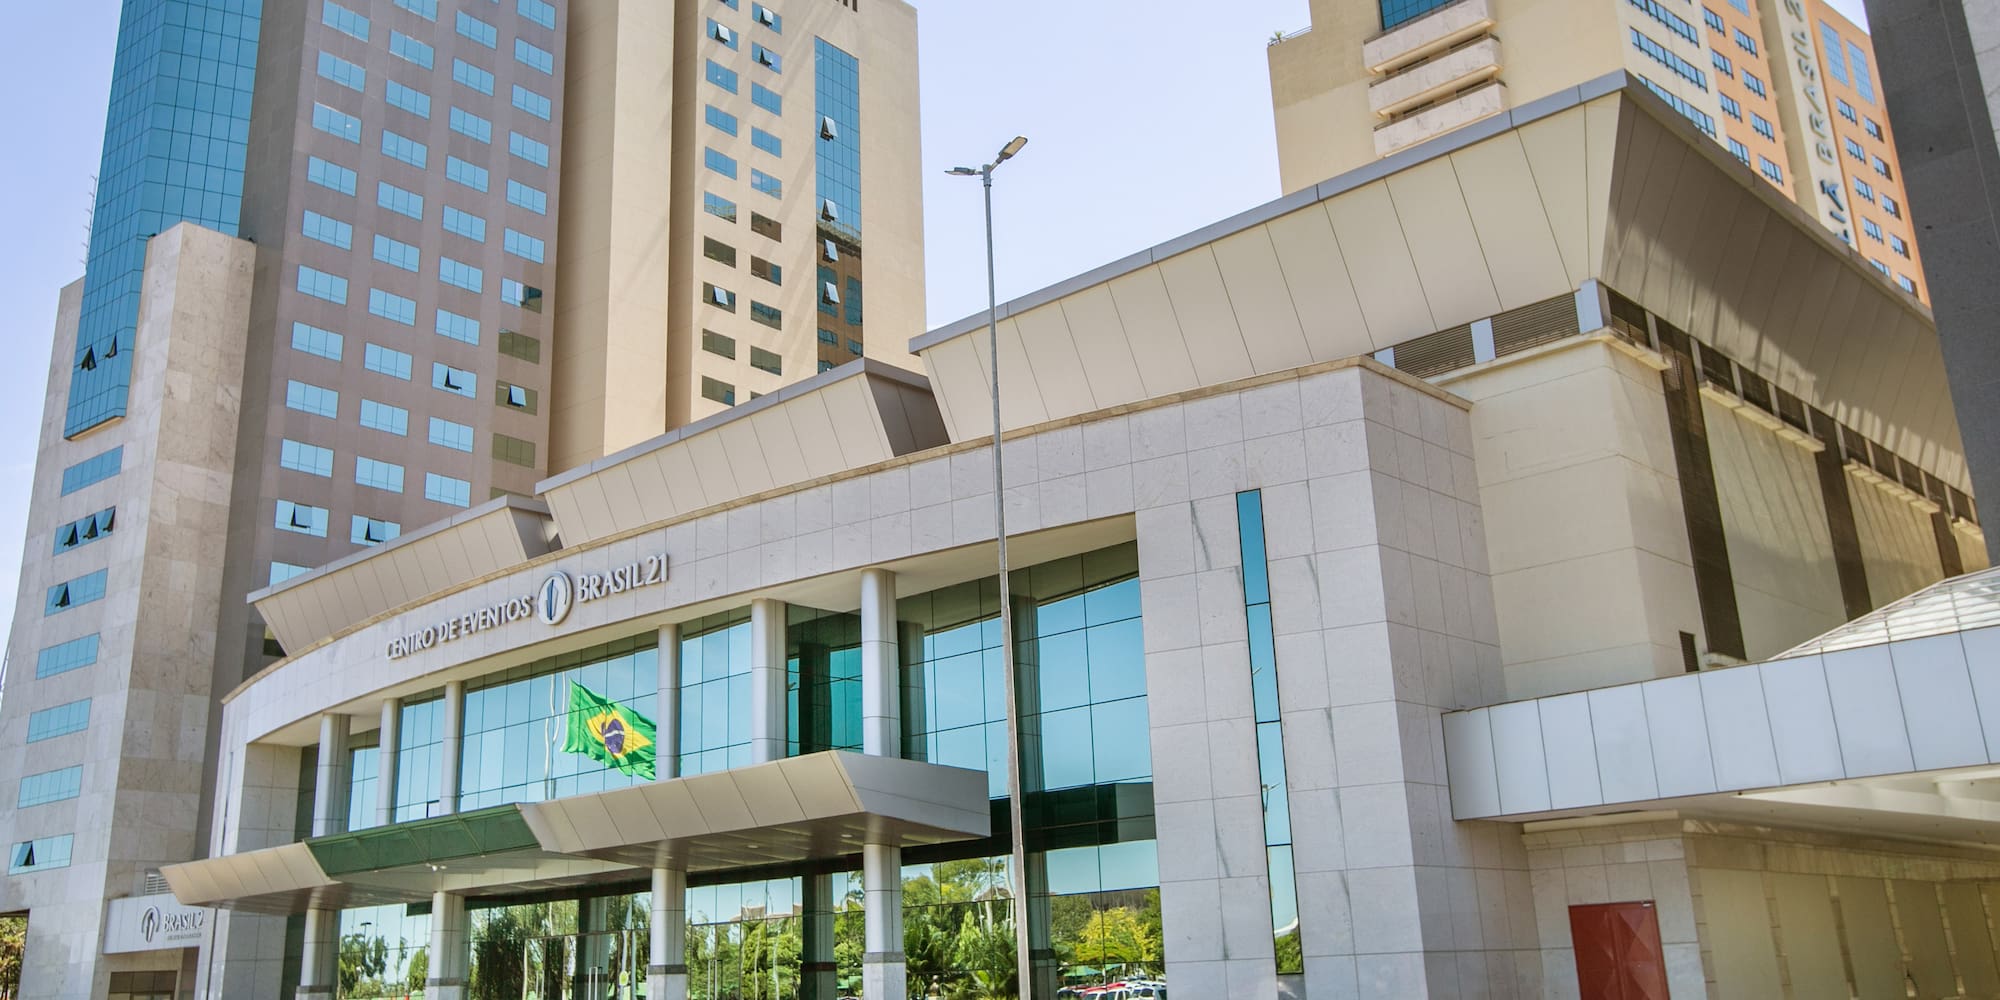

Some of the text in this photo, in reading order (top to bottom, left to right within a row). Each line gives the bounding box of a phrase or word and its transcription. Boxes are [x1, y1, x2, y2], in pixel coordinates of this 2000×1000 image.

[1791, 31, 1834, 165] BRASIL
[385, 552, 669, 660] CENTRO DE EVENTOS BRASIL 21
[163, 912, 197, 933] BRASIL
